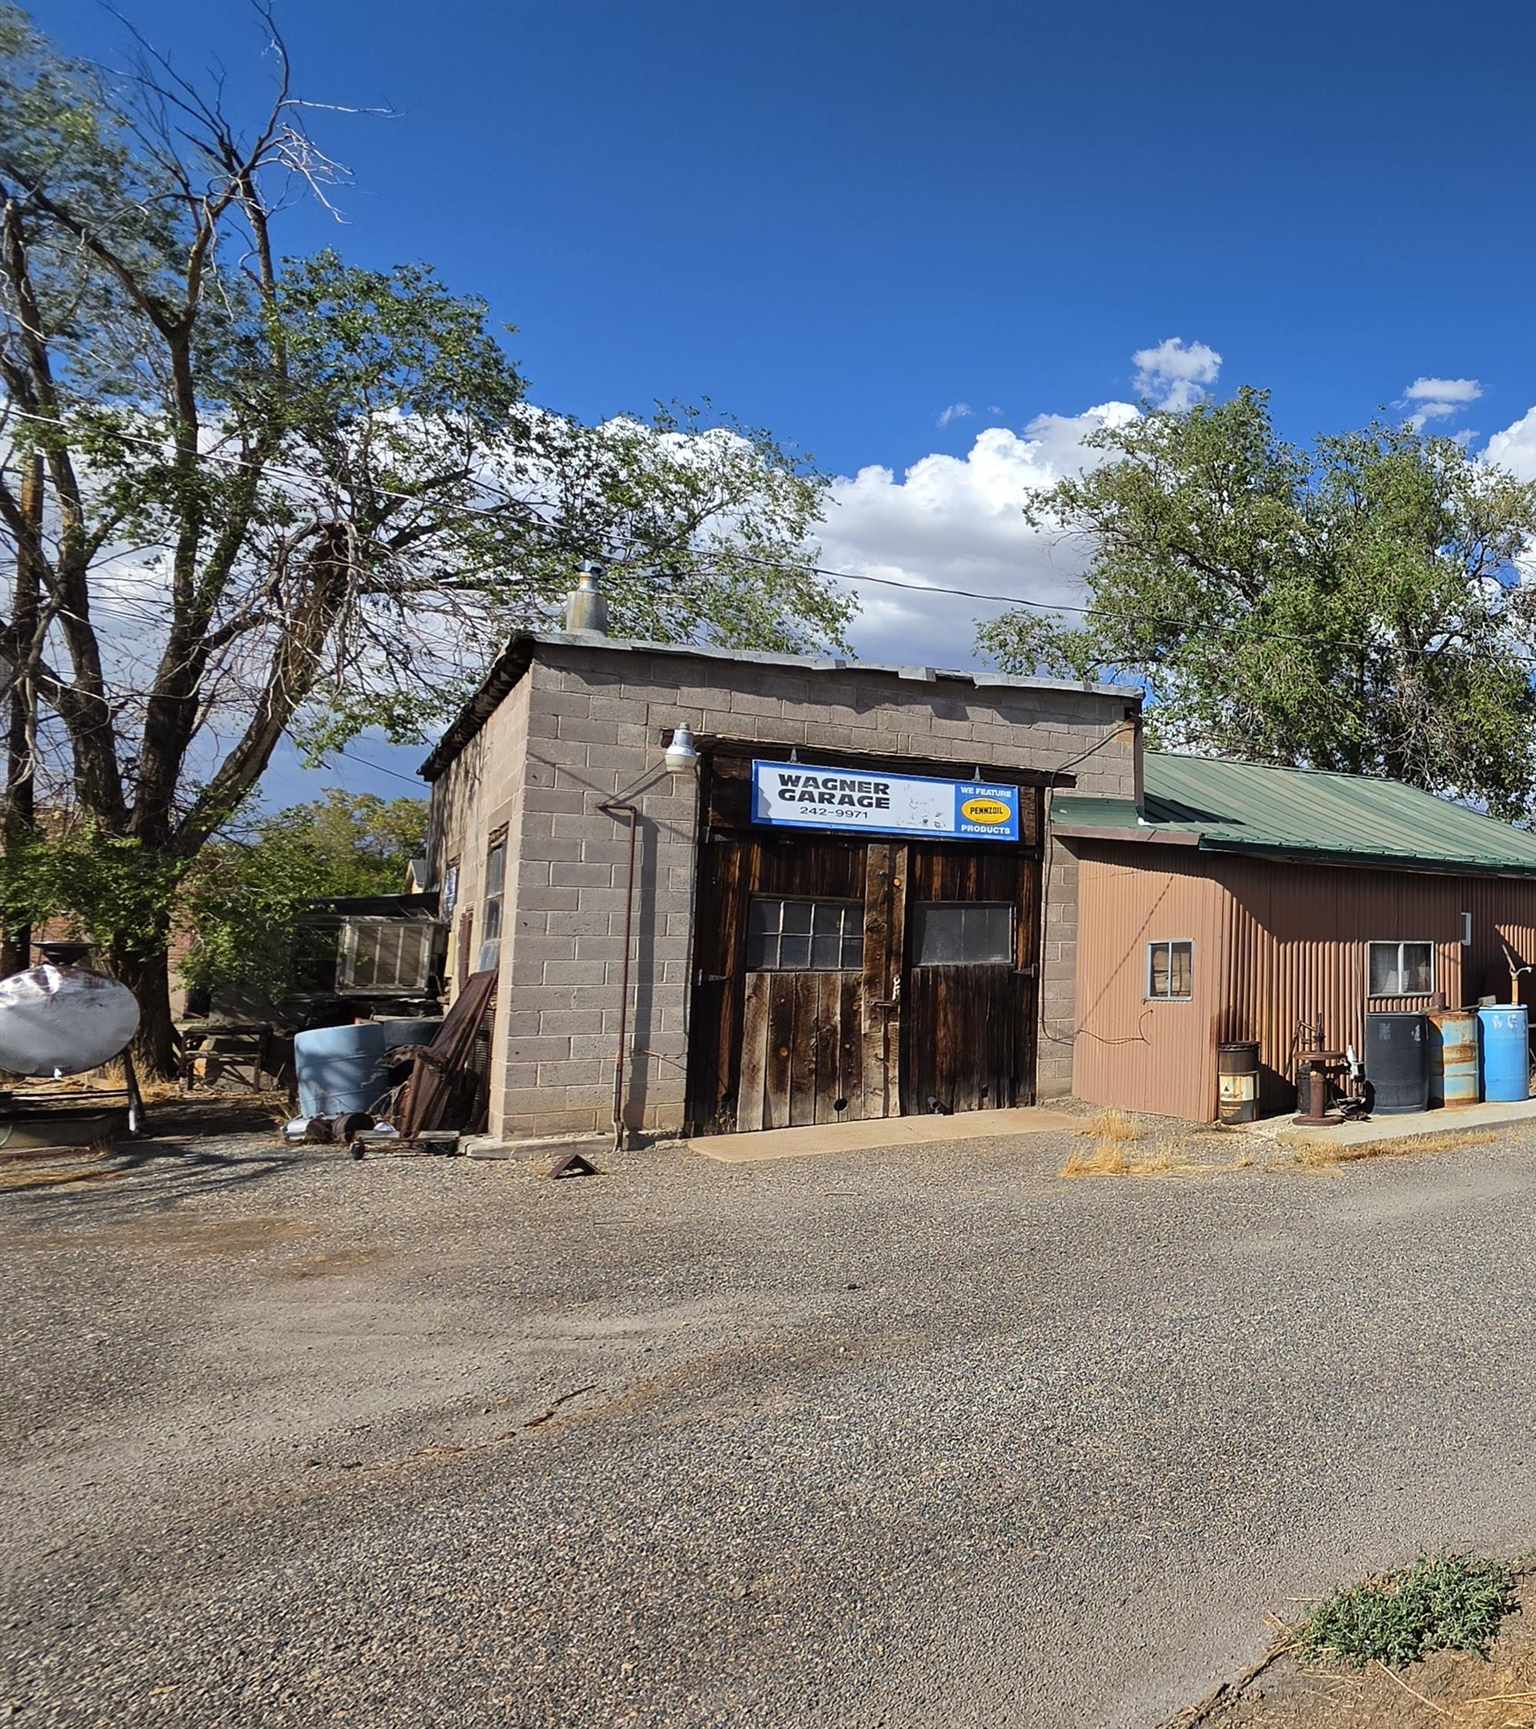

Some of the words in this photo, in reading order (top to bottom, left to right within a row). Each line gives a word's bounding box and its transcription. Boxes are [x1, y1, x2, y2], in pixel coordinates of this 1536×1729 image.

[778, 773, 890, 795] WAGNER
[778, 788, 890, 809] GARAGE
[961, 786, 974, 794] WE
[975, 788, 1012, 798] FEATURE
[800, 806, 868, 819] 242-9971
[961, 824, 1011, 834] PRODUCTS
